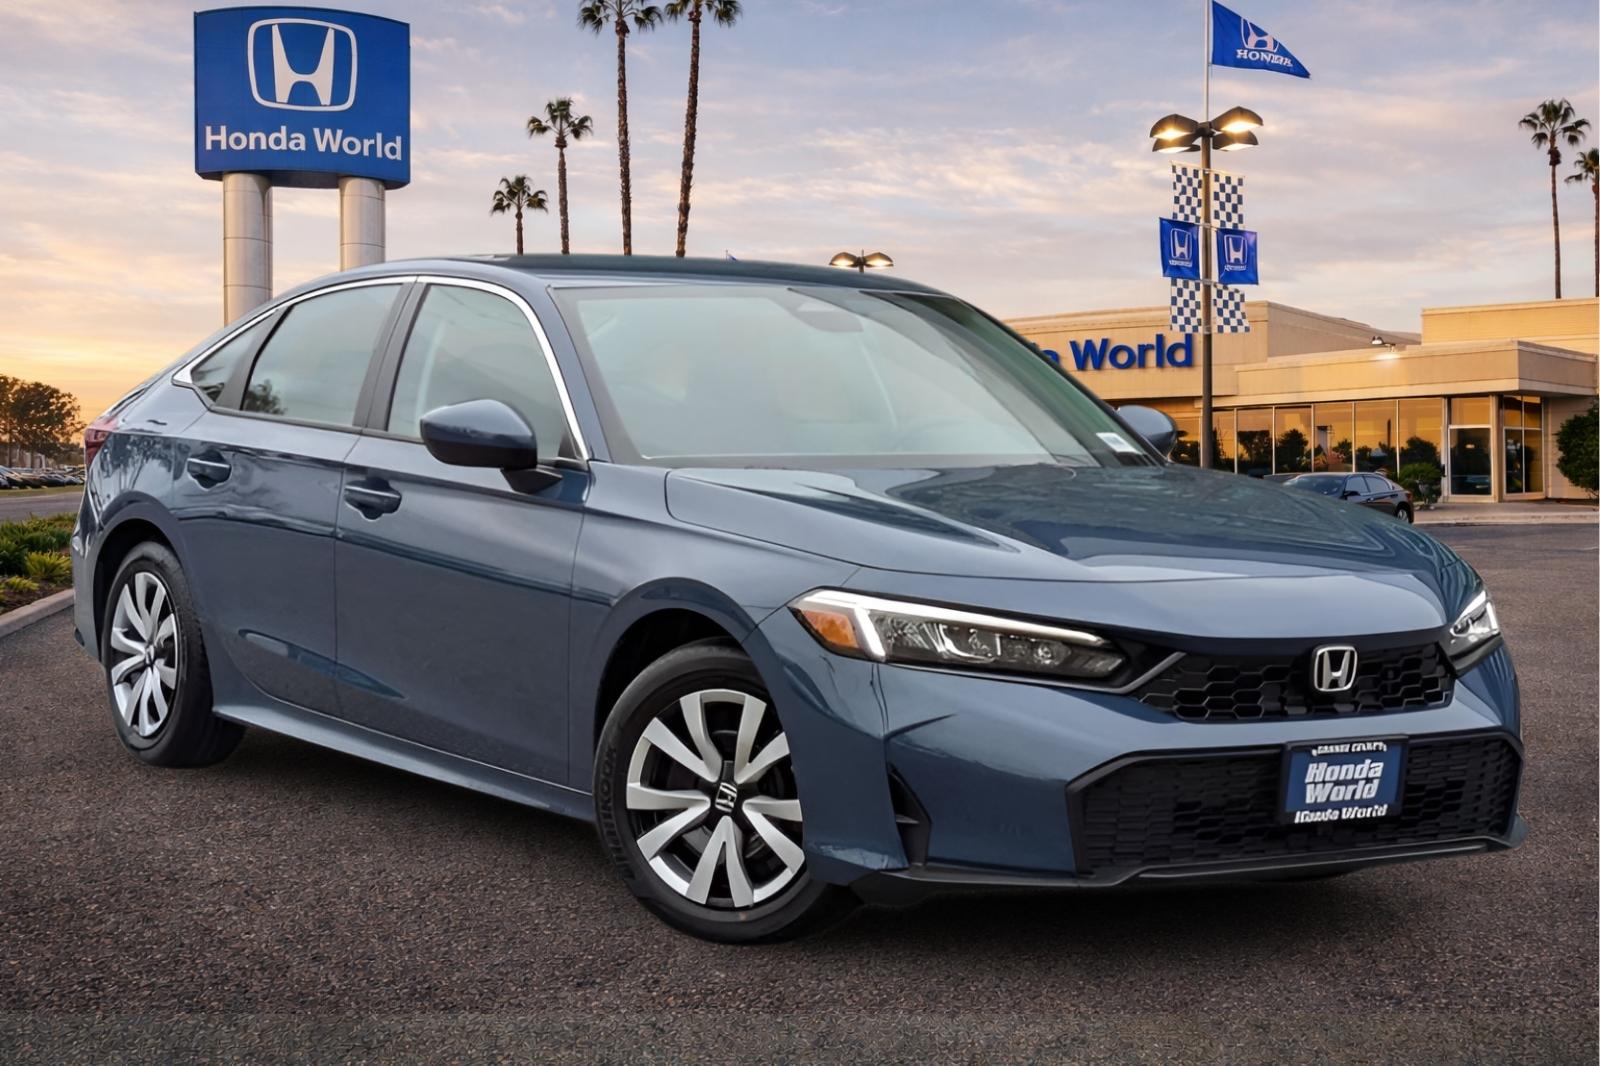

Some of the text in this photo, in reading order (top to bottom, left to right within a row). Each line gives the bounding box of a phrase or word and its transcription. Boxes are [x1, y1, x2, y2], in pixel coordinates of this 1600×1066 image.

[205, 125, 402, 161] Honda World
[1069, 333, 1193, 371] World
[1305, 759, 1384, 783] Honda
[1305, 779, 1380, 804] World
